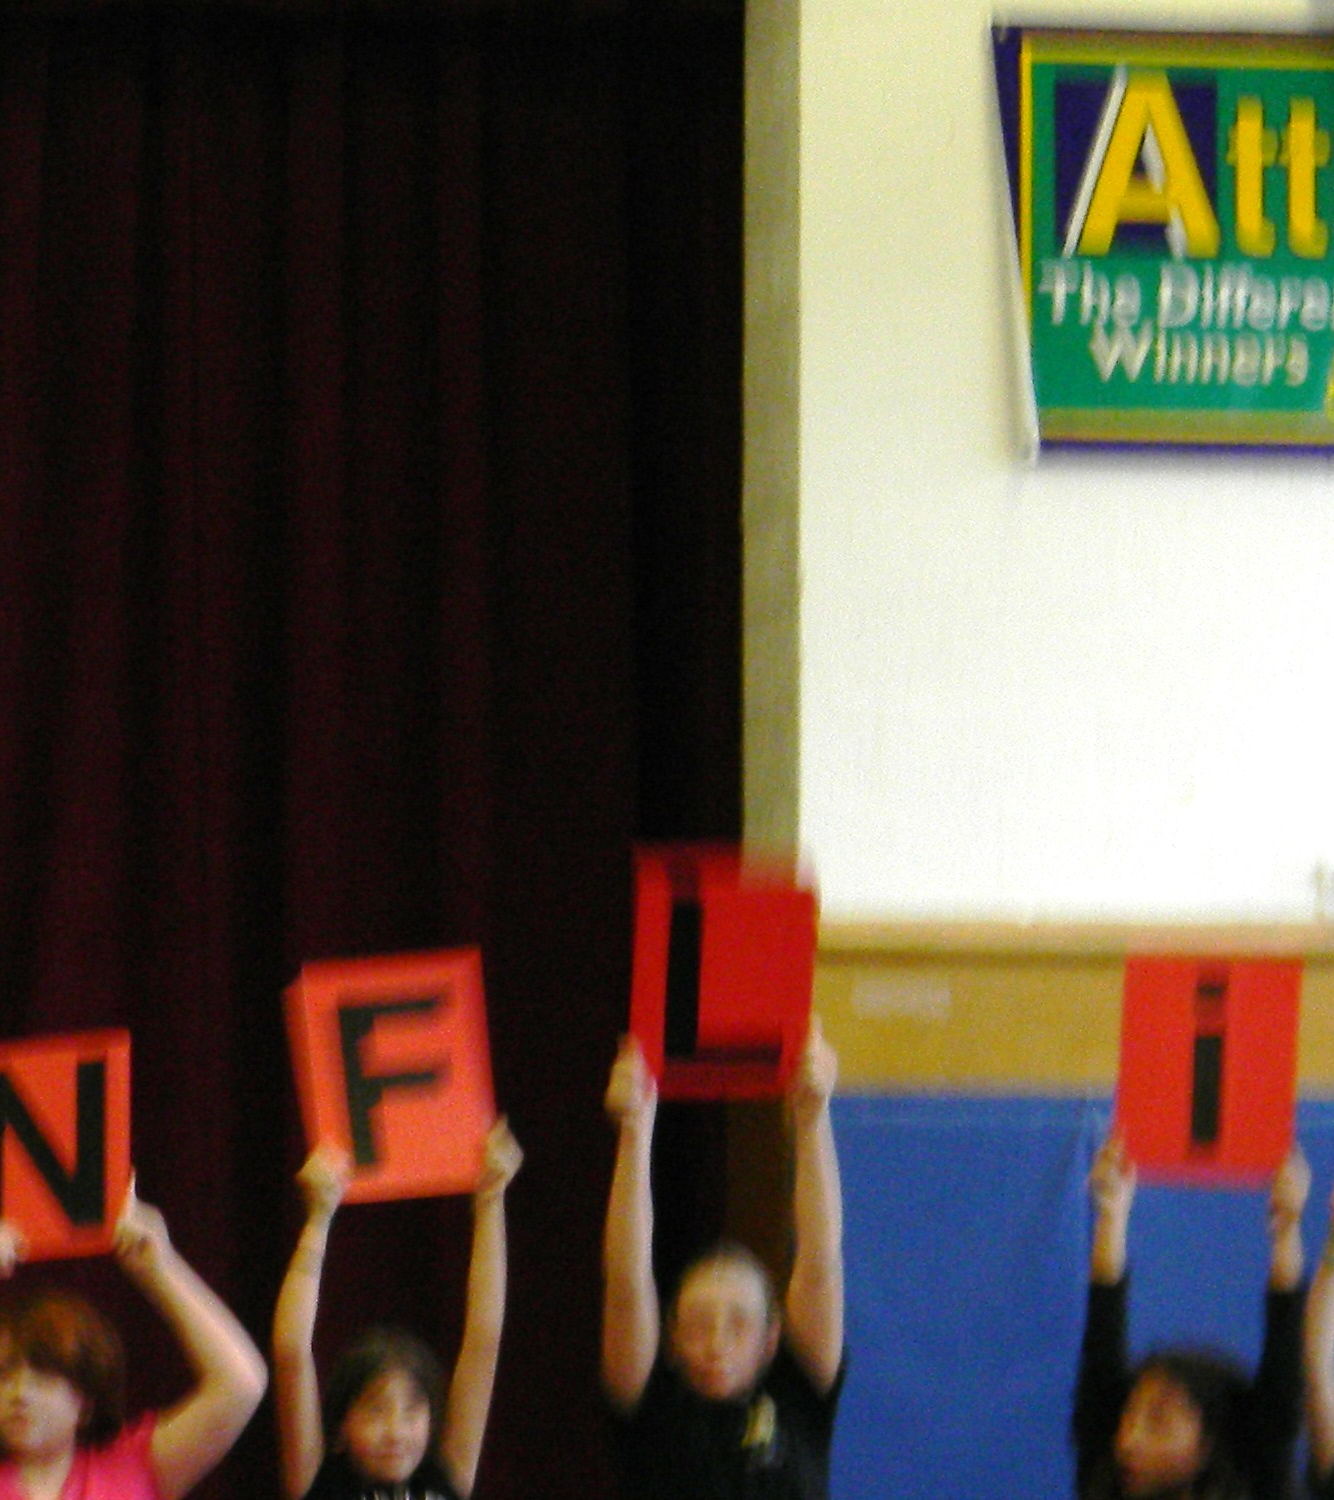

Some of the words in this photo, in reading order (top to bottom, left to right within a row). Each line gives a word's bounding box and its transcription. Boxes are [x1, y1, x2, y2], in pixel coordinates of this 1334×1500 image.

[1041, 259, 1142, 327] The
[1089, 322, 1310, 386] Winners
[338, 982, 455, 1168] F
